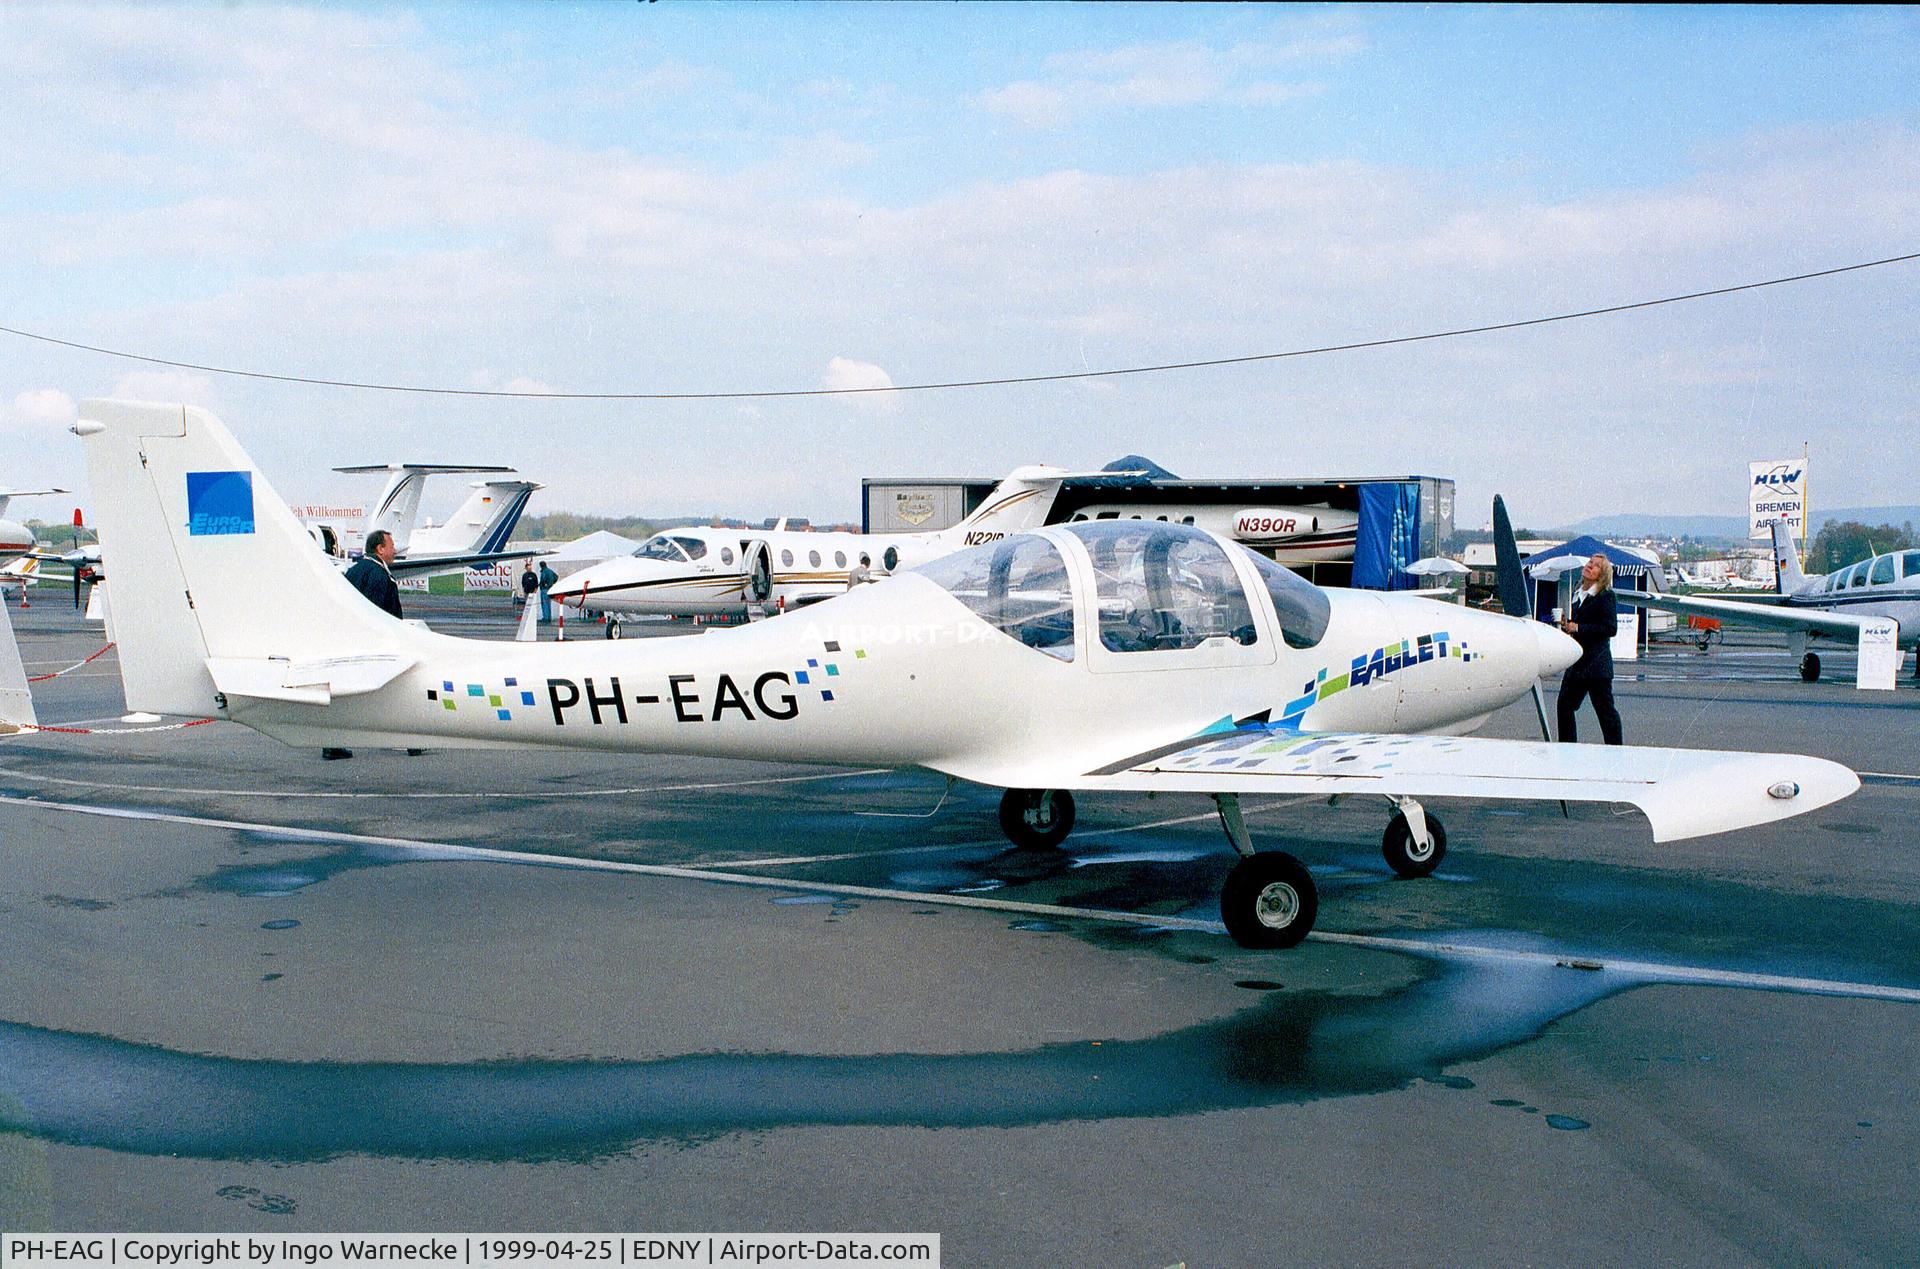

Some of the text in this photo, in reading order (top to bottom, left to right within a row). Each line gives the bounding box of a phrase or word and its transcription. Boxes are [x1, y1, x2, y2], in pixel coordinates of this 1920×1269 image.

[1754, 469, 1802, 485] HLW
[306, 505, 362, 517] Willkommen
[1756, 501, 1801, 512] BREMEN
[1239, 518, 1296, 532] N390R
[1755, 518, 1801, 529] AIRPRT
[1350, 631, 1450, 687] EAGLET
[547, 671, 800, 726] PH-EAG
